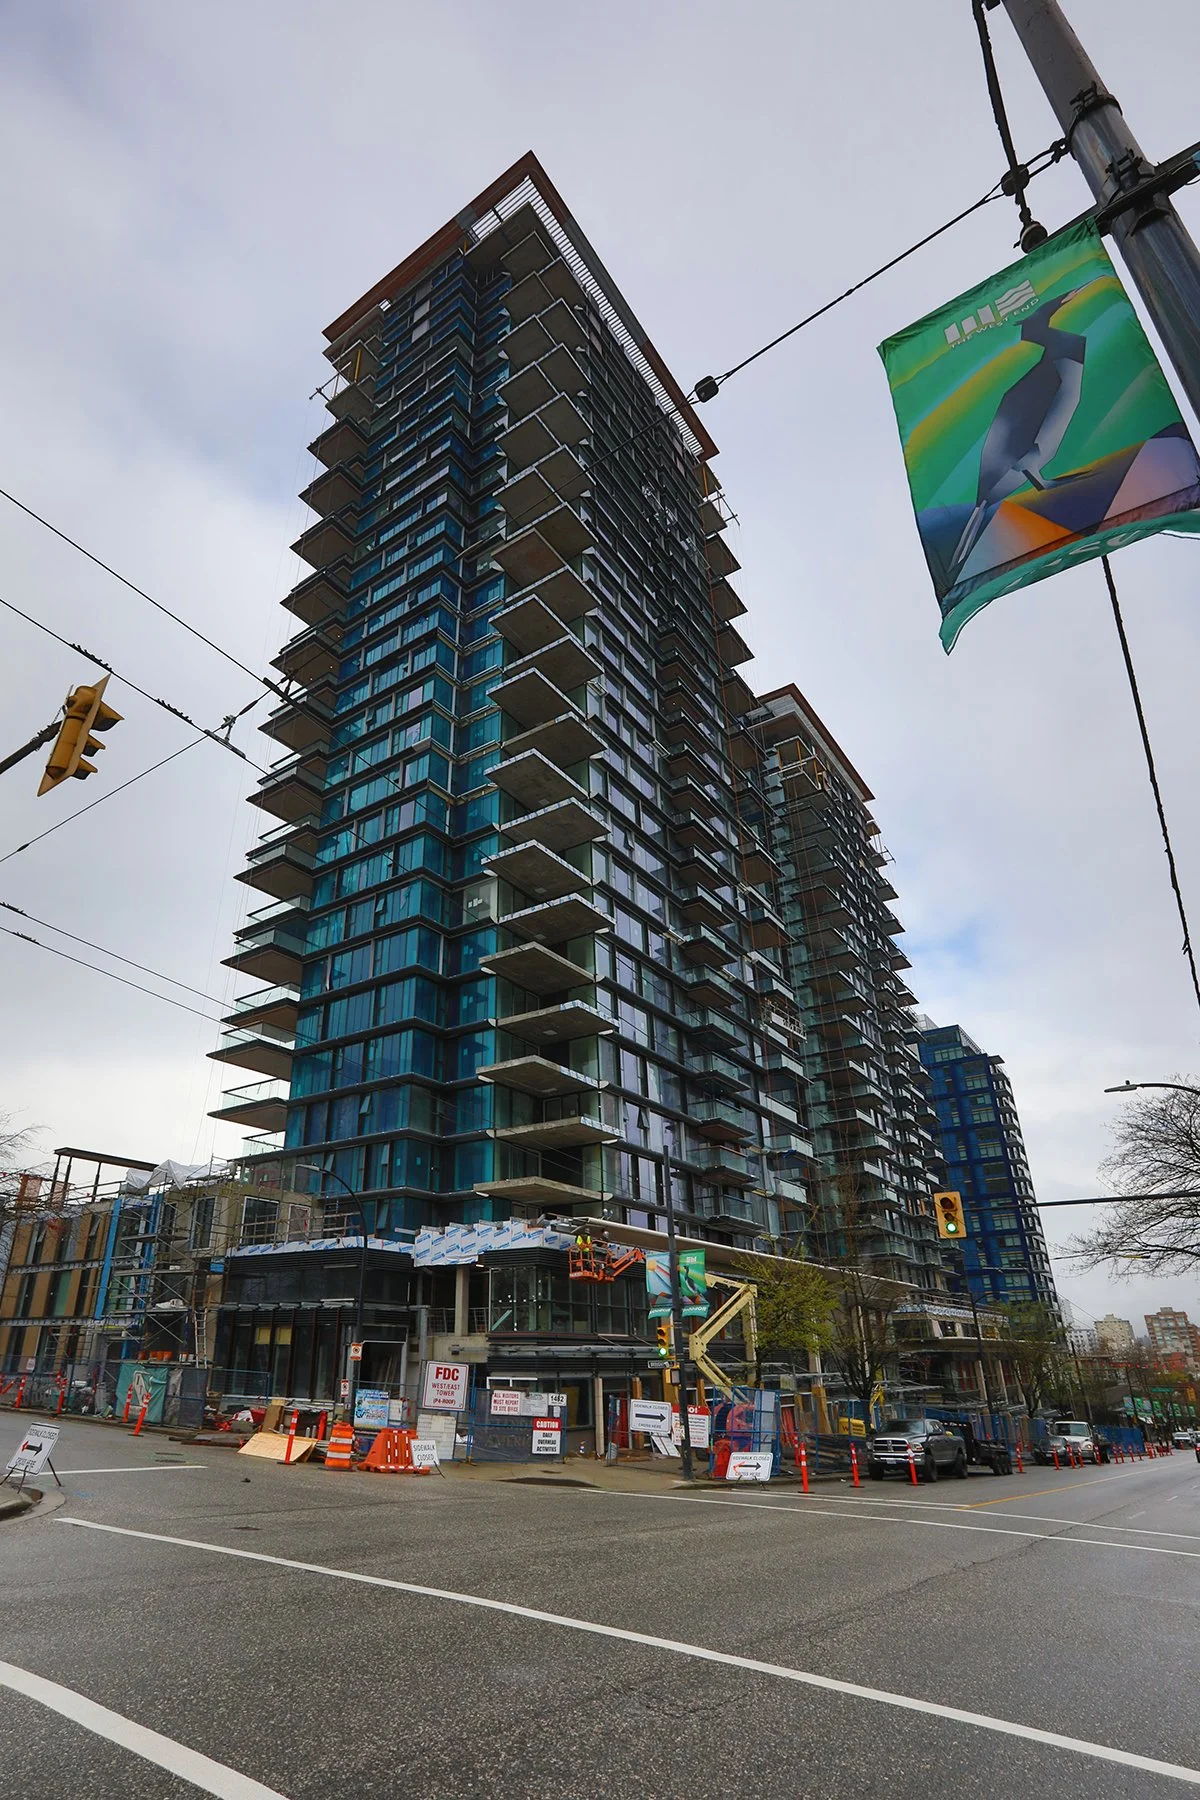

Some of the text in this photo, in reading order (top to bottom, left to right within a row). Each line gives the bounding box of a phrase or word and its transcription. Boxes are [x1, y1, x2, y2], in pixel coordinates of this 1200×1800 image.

[950, 298, 1040, 349] THE WEST END
[435, 1366, 460, 1381] FDC
[436, 1389, 455, 1397] TOWER
[536, 1420, 559, 1429] CAUTION
[417, 1453, 435, 1461] CLOSED
